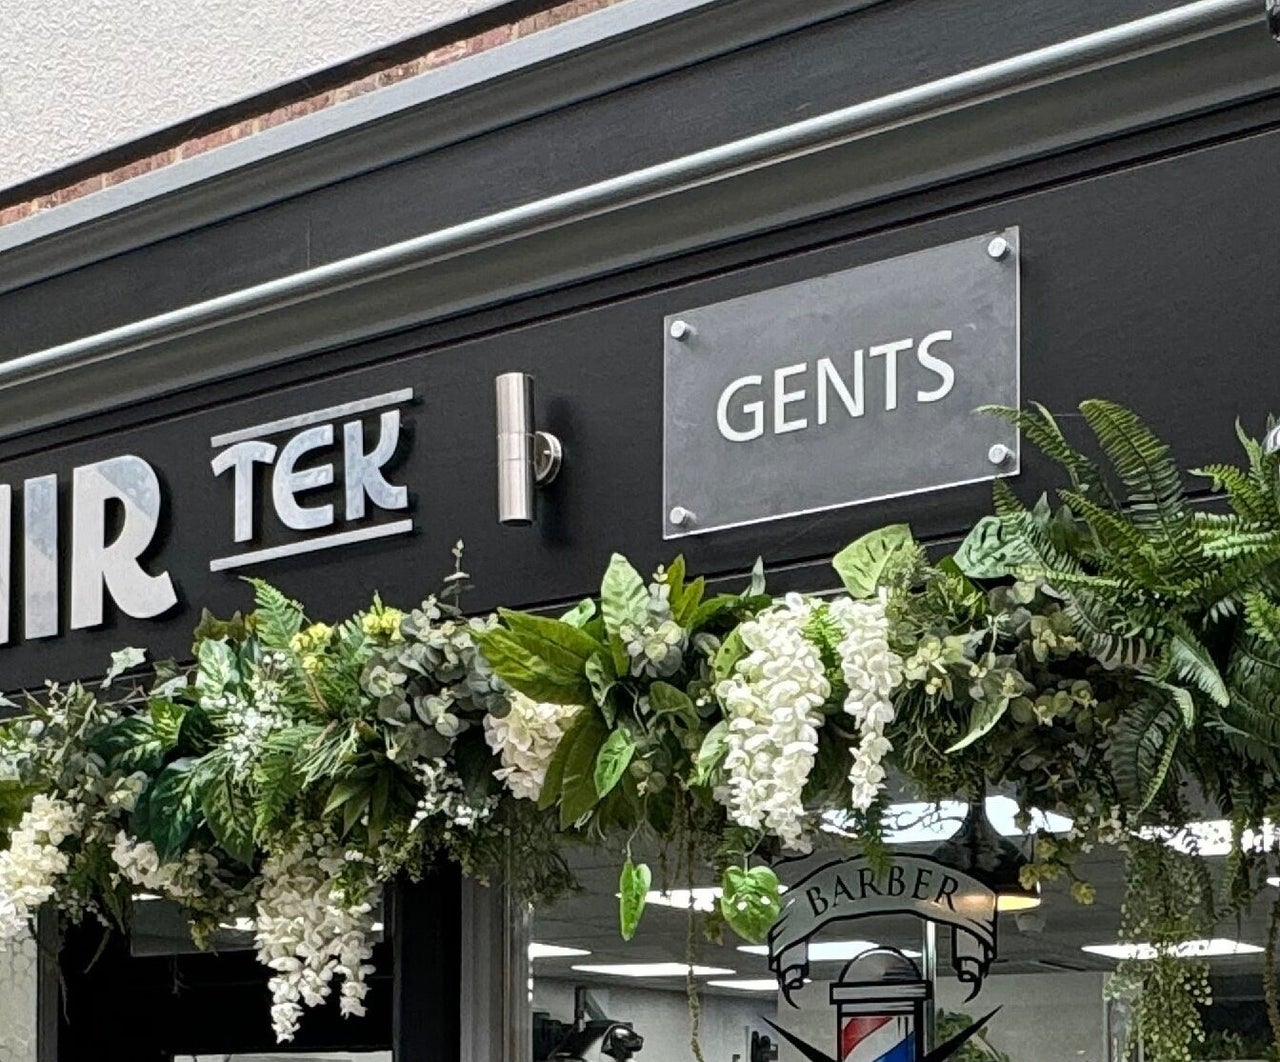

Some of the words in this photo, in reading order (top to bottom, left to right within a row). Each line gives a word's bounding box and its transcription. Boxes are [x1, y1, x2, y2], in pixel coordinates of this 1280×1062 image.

[716, 330, 955, 442] GENTS
[210, 409, 409, 543] TEK
[805, 865, 959, 918] BARBER
